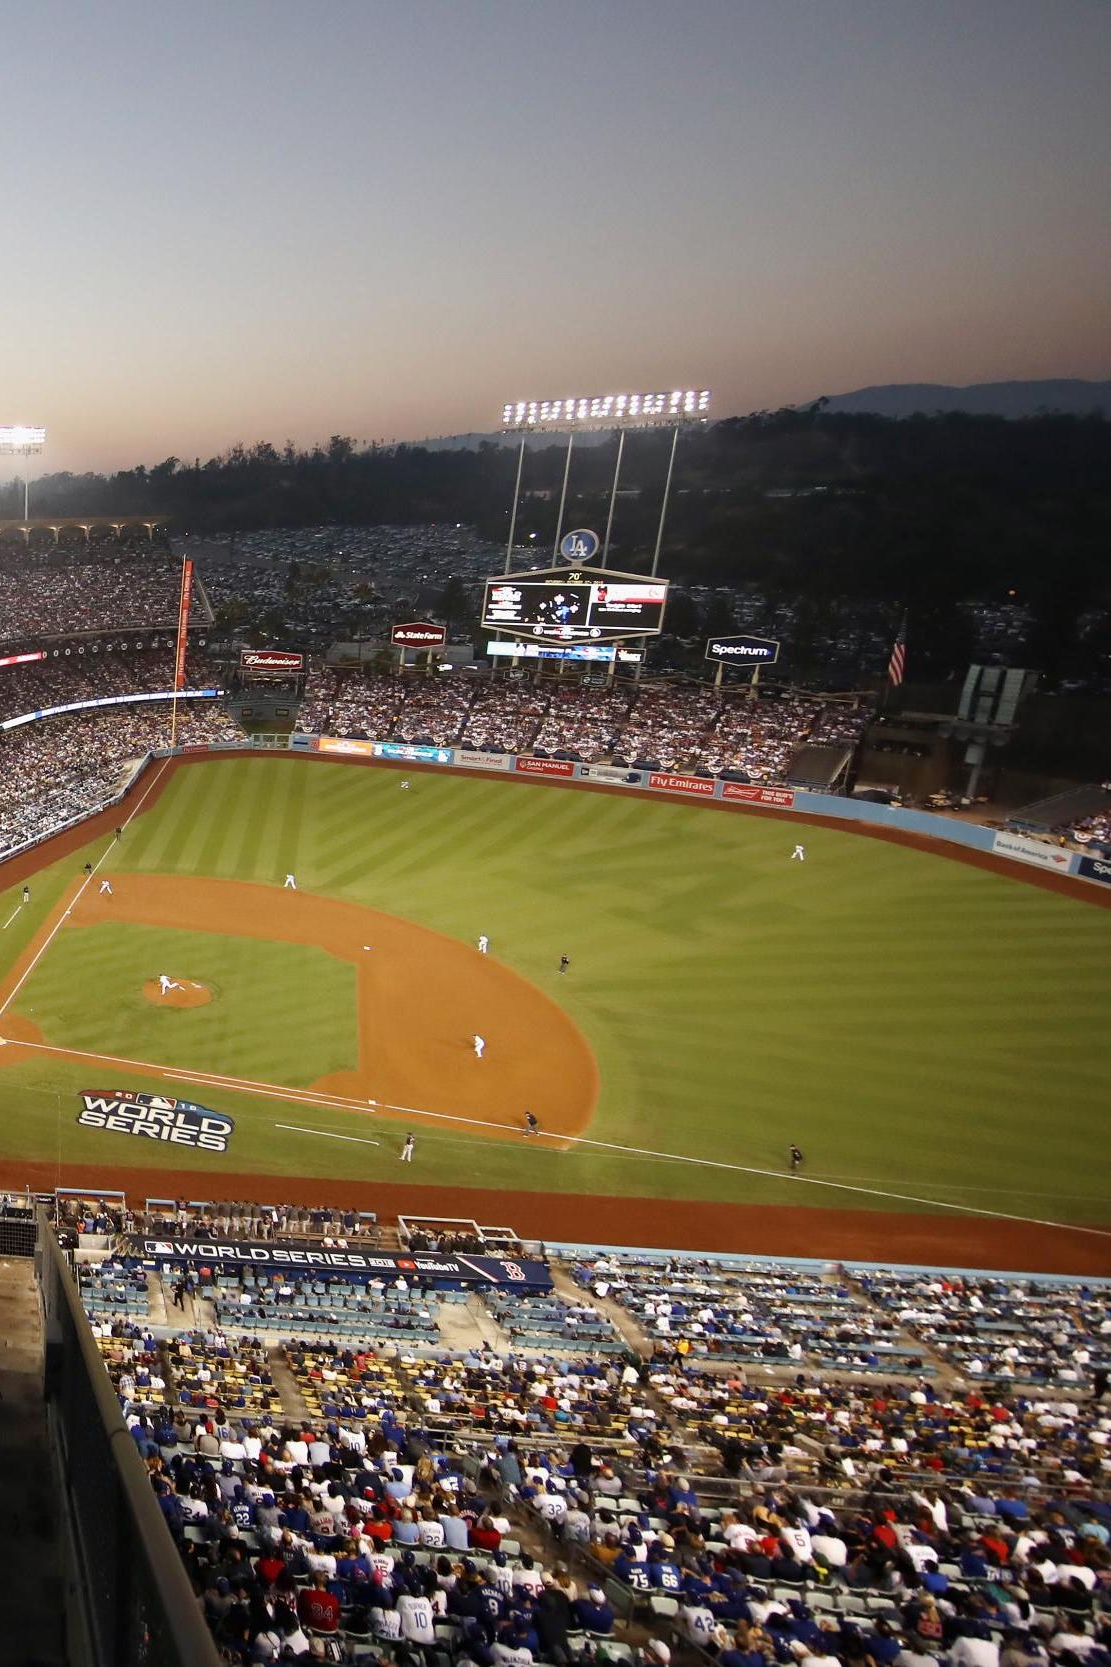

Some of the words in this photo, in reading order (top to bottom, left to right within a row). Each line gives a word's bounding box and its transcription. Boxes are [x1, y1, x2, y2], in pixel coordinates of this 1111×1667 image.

[569, 535, 587, 557] LA
[712, 644, 768, 656] Spectrum
[244, 654, 300, 666] Budweiser
[542, 762, 570, 770] MANUEL
[651, 776, 668, 787] Fly
[669, 778, 714, 792] Emirates
[996, 840, 1013, 850] Bank
[1021, 847, 1048, 860] America
[83, 1096, 233, 1135] WORLD
[78, 1110, 227, 1151] SERIES
[174, 1243, 270, 1261] WORLD
[272, 1250, 366, 1267] SERIES
[500, 1261, 526, 1281] B
[235, 1513, 250, 1526] 22
[628, 1574, 649, 1588] 75
[661, 1574, 679, 1587] 66
[414, 1612, 427, 1629] 10
[694, 1616, 715, 1632] 42
